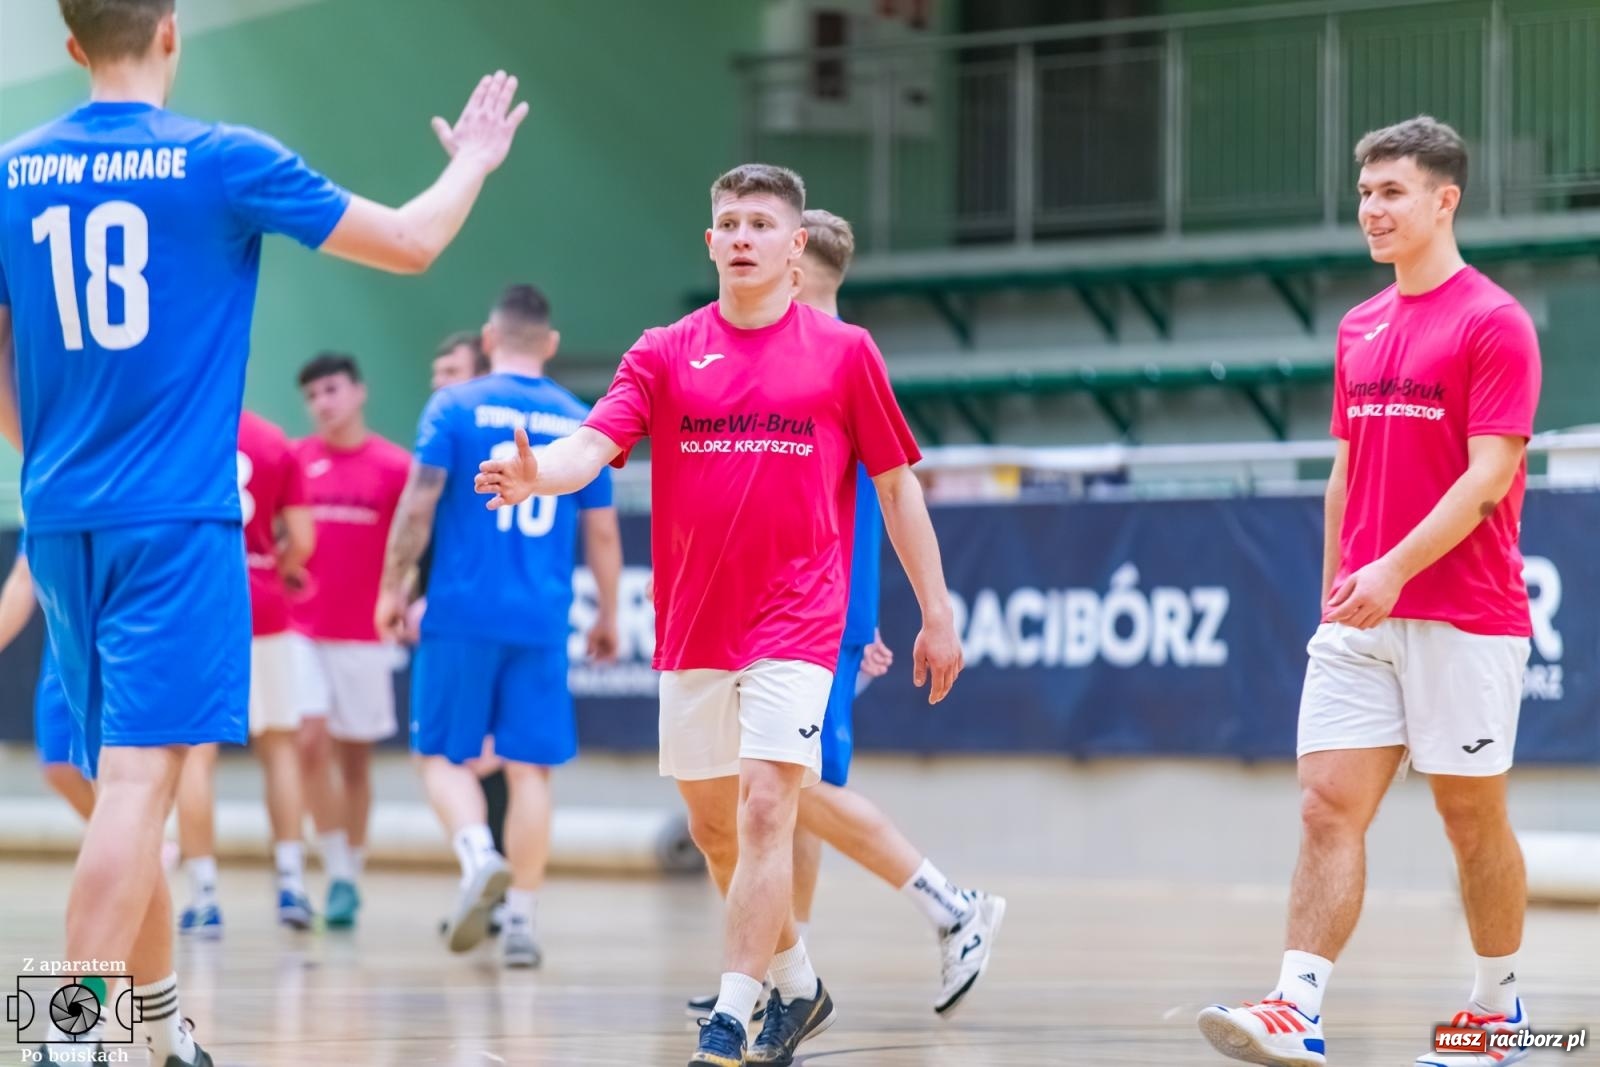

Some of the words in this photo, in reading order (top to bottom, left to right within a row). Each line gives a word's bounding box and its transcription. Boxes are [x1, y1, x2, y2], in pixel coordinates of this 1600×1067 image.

[7, 154, 88, 189] STOPIW
[92, 147, 188, 183] GARAGE
[31, 200, 150, 351] 18
[680, 413, 816, 437] AmeWi-Bruk
[680, 440, 732, 453] KOLORZ
[735, 440, 814, 456] KRZYSZTOF
